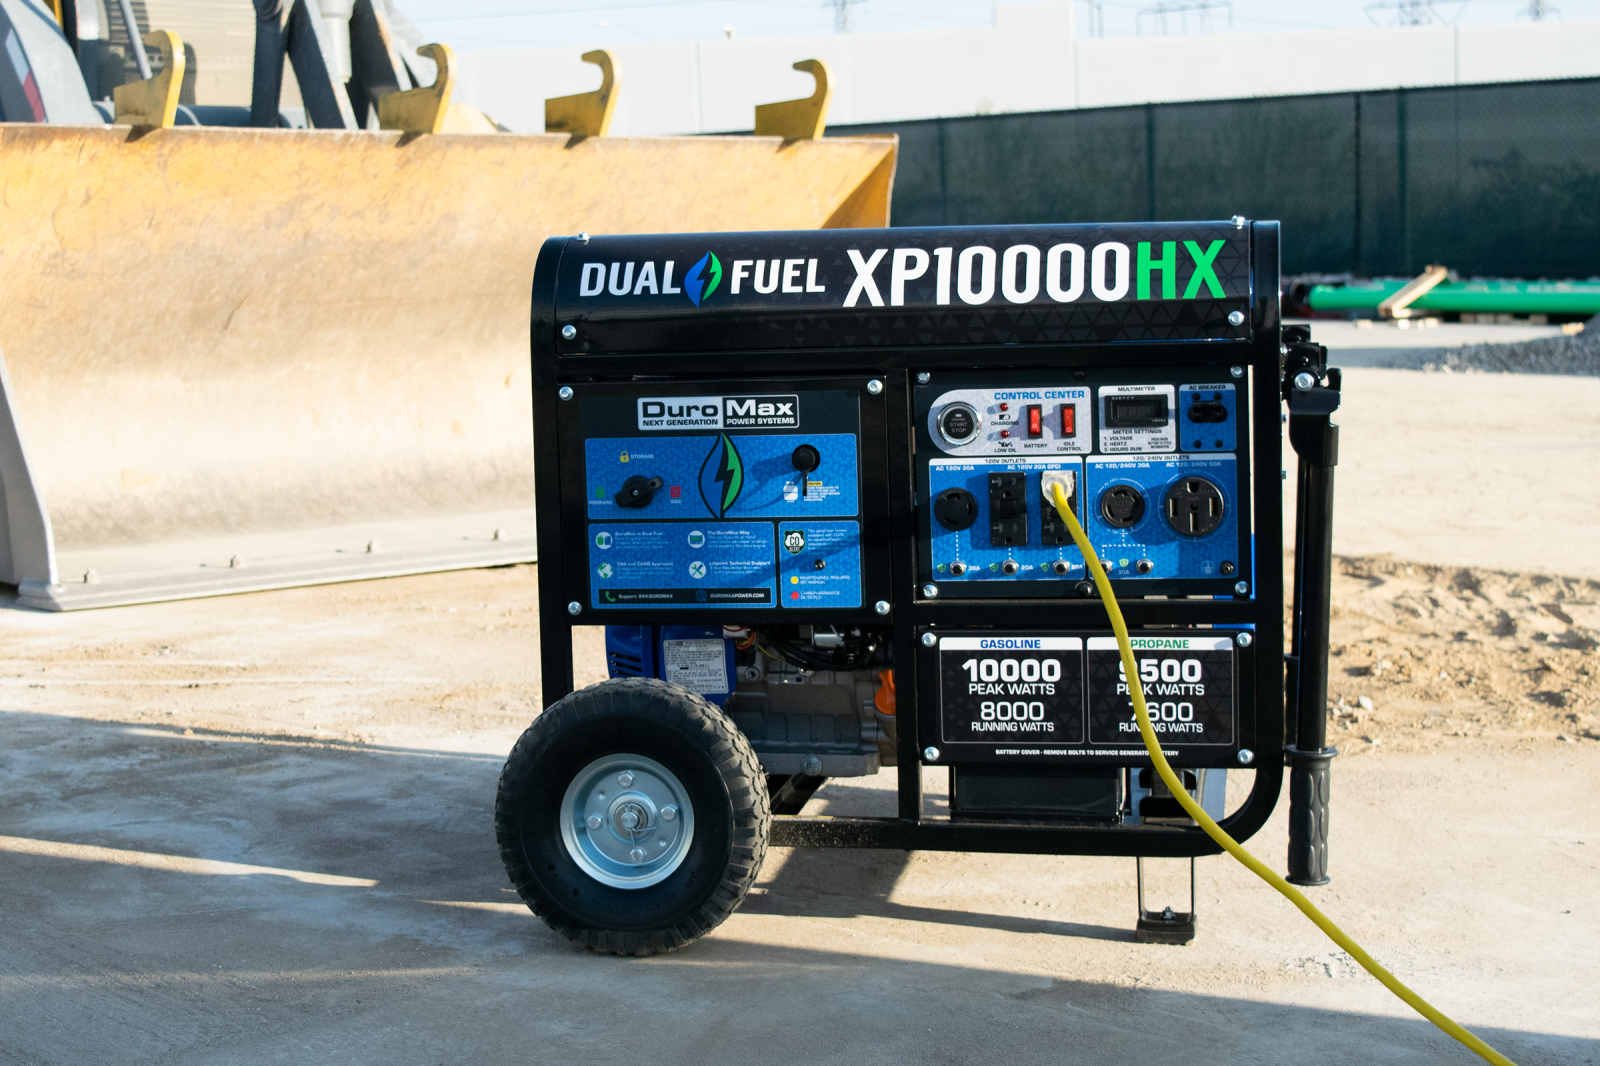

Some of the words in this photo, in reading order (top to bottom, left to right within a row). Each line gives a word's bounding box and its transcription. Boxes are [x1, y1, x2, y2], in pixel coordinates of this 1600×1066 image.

[579, 260, 681, 297] DUAL
[730, 258, 826, 295] FUEL
[842, 239, 1227, 308] XP10000HX
[994, 391, 1043, 400] CONTROL
[1044, 390, 1085, 399] CENTER
[643, 419, 665, 427] NEXT
[666, 418, 719, 426] GENERATION
[726, 417, 756, 426] POWER
[757, 416, 795, 425] SYSTEMS
[1104, 462, 1137, 470] 120/240V
[789, 536, 800, 546] CO
[967, 564, 981, 572] 30A
[980, 639, 1042, 649] GASOLINE
[1130, 639, 1190, 649] PROPANE
[961, 658, 1062, 683] 10000
[968, 683, 1005, 695] PEAK
[1006, 683, 1056, 695] WATTS
[1116, 683, 1154, 695] PEK
[1155, 683, 1205, 696] WATTS
[980, 701, 1045, 721] 8000
[971, 721, 1018, 732] RUNNING
[1019, 721, 1055, 732] WATTS
[1118, 722, 1167, 733] RUNNG
[1167, 722, 1204, 733] WATTS
